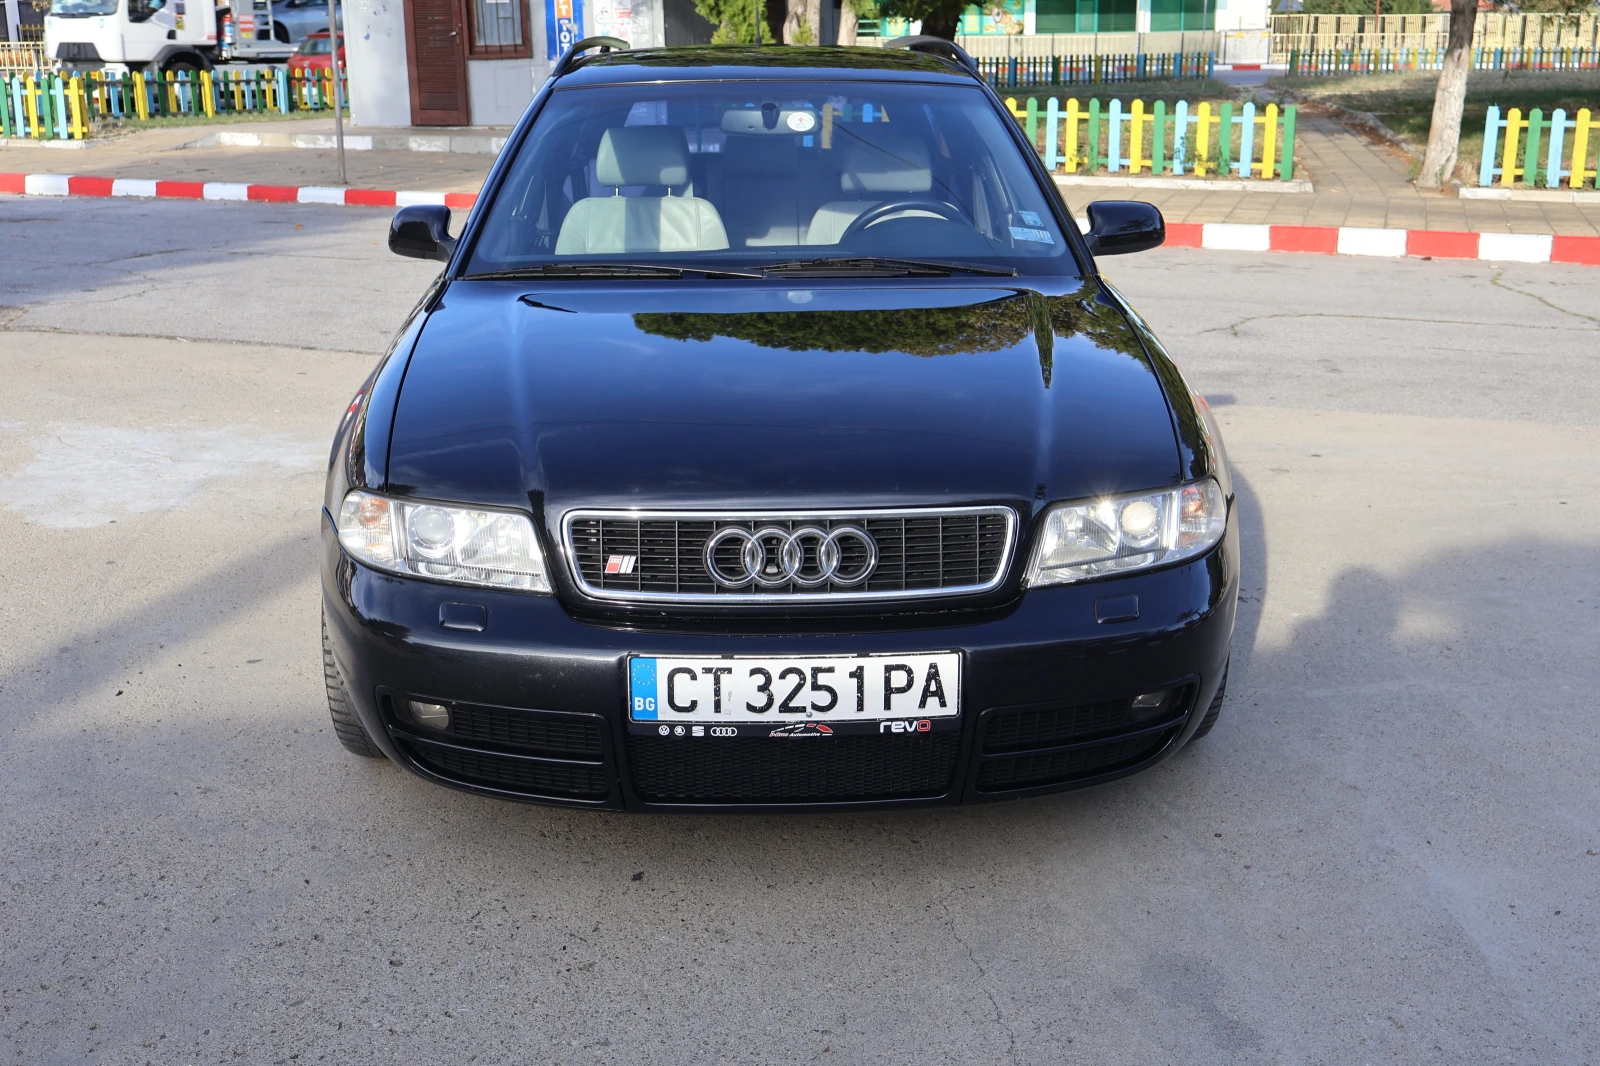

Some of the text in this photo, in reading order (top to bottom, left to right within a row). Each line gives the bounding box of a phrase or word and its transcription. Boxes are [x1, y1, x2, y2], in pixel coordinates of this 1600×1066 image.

[634, 696, 656, 711] BG
[667, 662, 948, 714] CT 3251 PA
